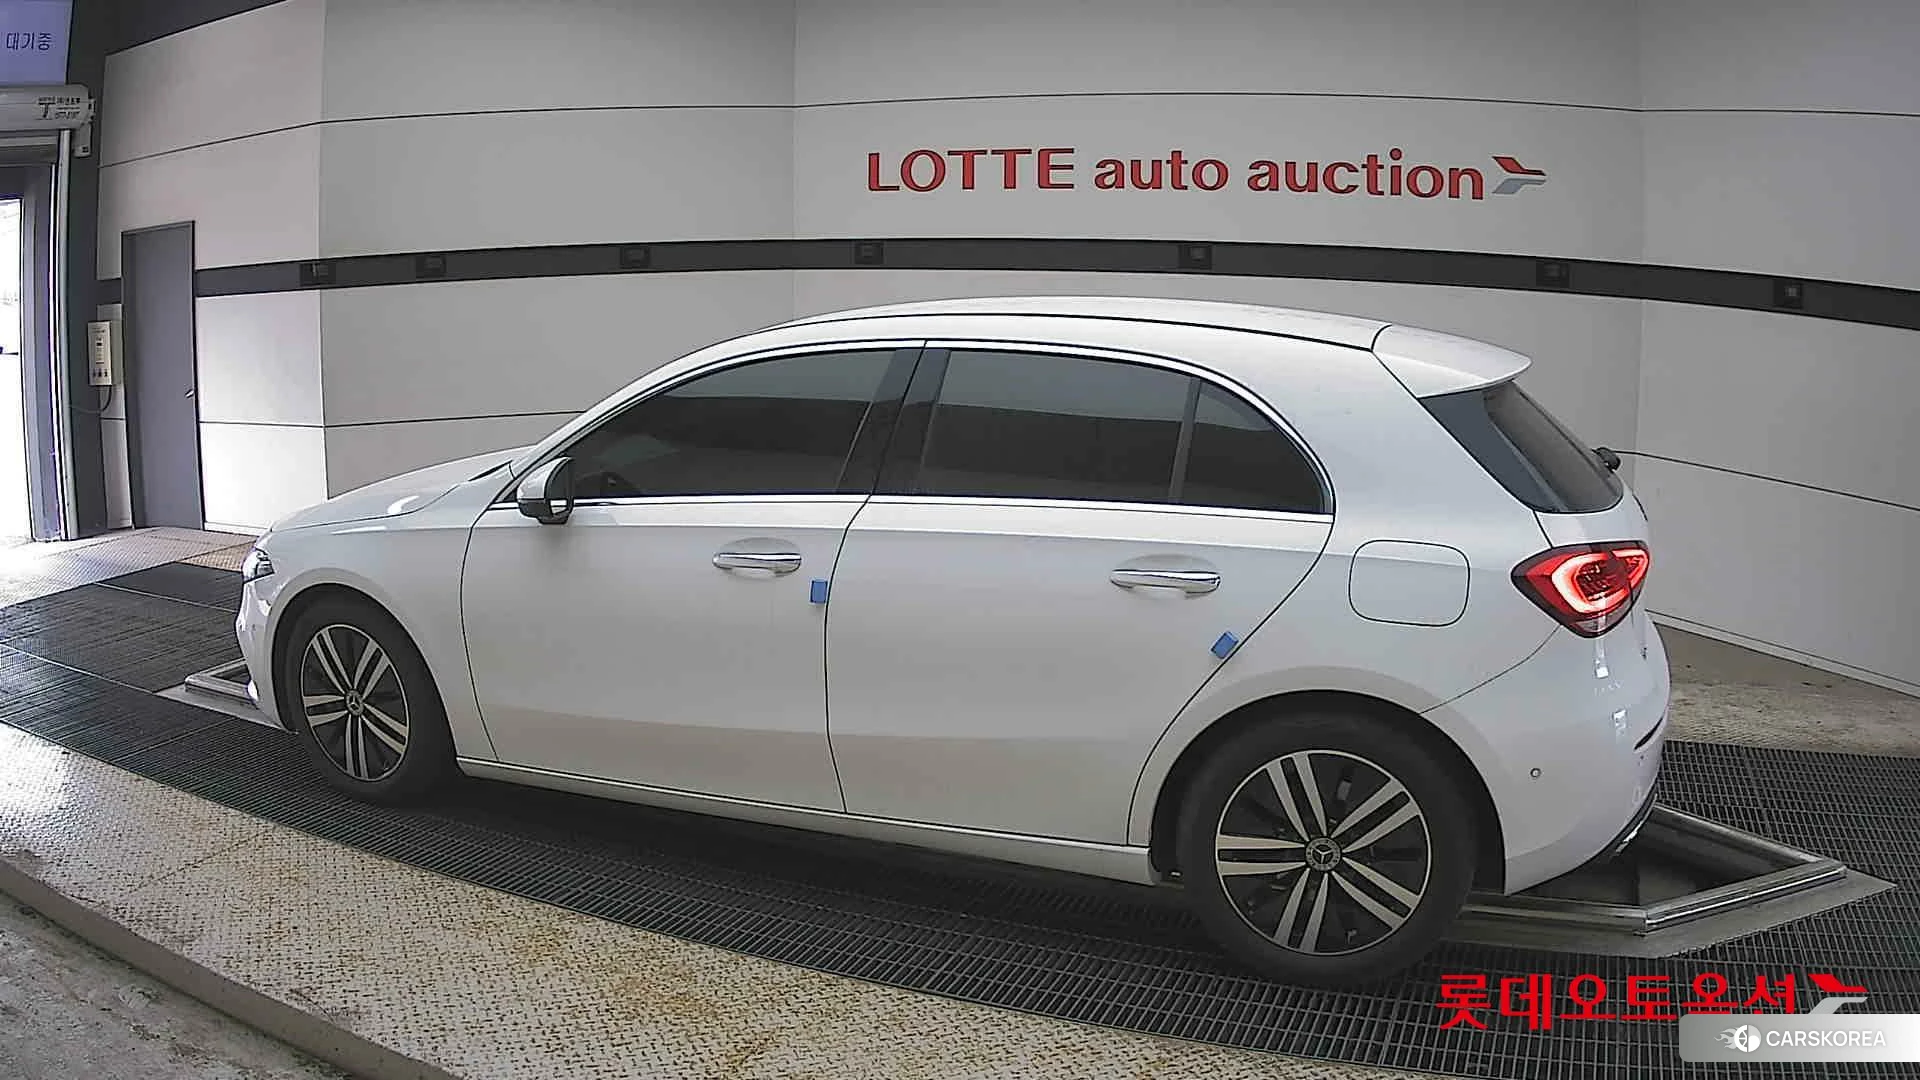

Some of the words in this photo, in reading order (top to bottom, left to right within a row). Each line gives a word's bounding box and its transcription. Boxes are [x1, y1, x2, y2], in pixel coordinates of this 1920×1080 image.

[6, 31, 52, 51] 대기중
[867, 148, 1074, 193] LOTTE
[1094, 151, 1228, 190] auto
[1248, 148, 1484, 200] auction
